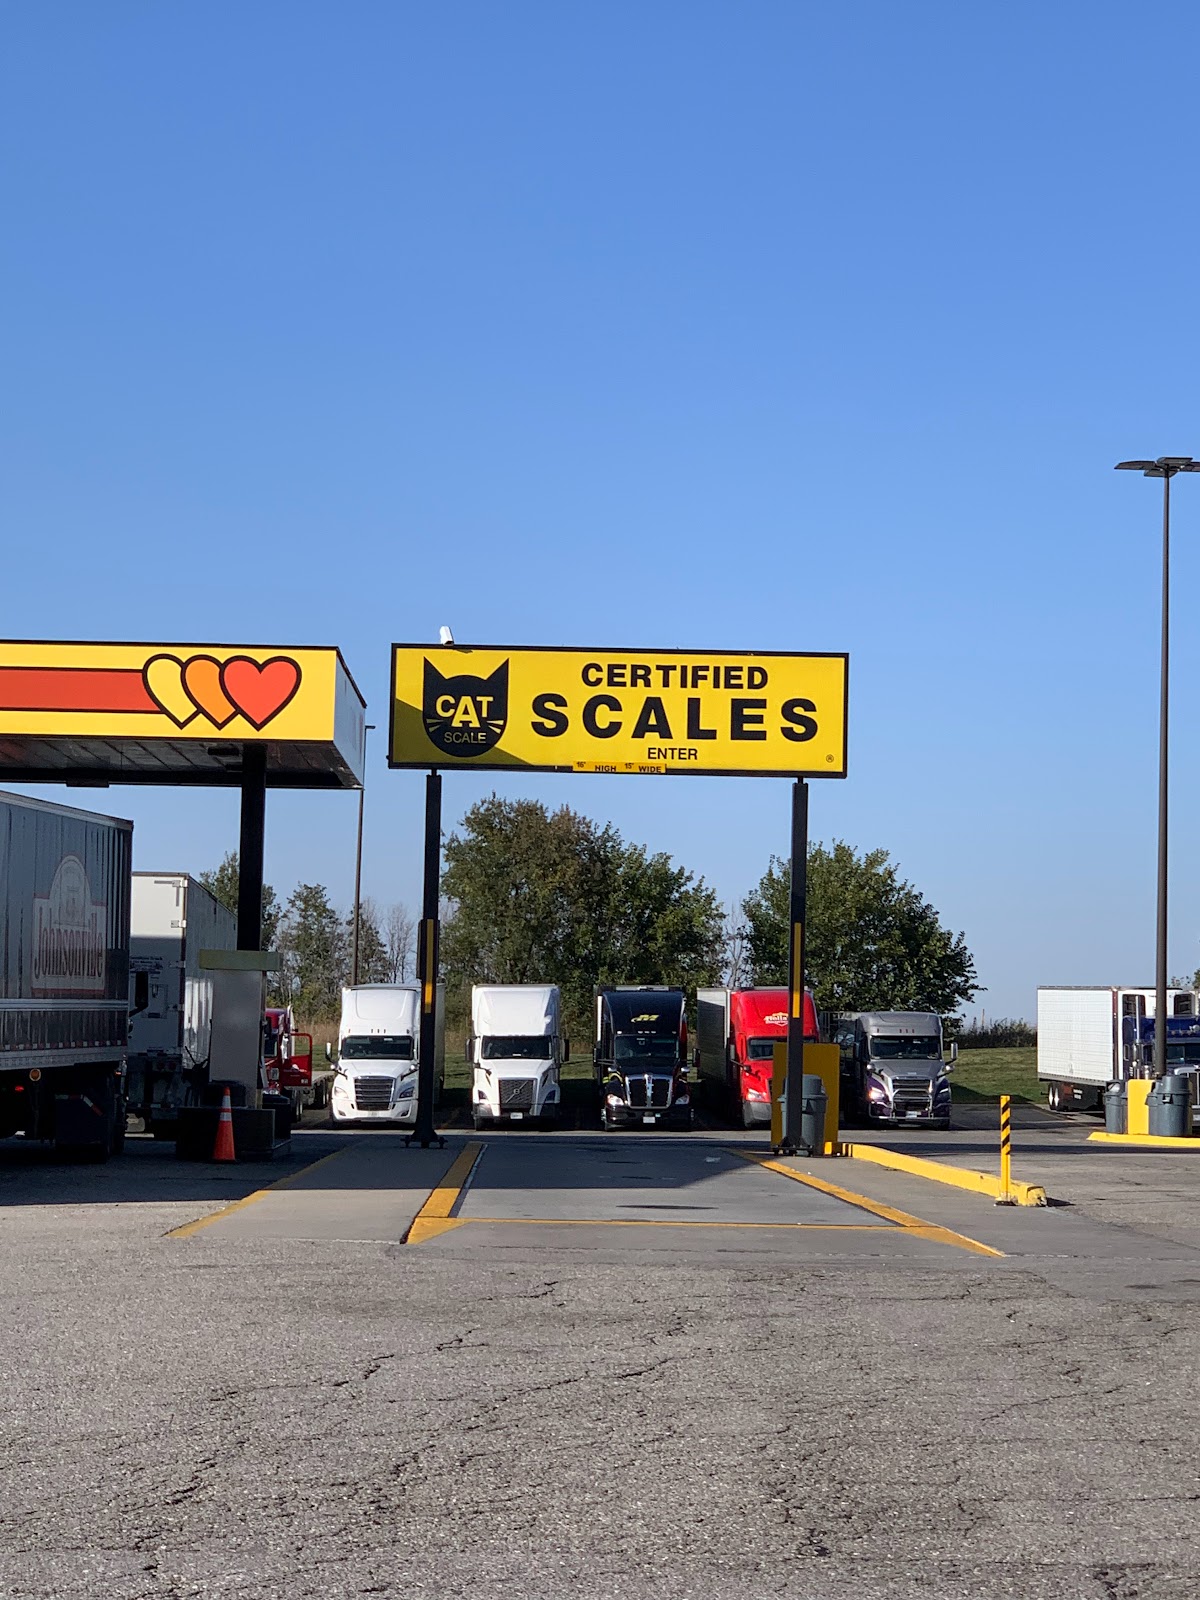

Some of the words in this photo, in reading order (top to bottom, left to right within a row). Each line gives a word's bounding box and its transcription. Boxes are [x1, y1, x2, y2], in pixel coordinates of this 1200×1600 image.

[581, 662, 769, 690] CERTIFIED
[435, 694, 494, 728] CAT
[531, 693, 818, 742] SCALES
[443, 731, 487, 744] SCALE
[647, 747, 698, 761] ENTER
[638, 765, 662, 773] WIDE
[34, 905, 104, 980] Johnsonville
